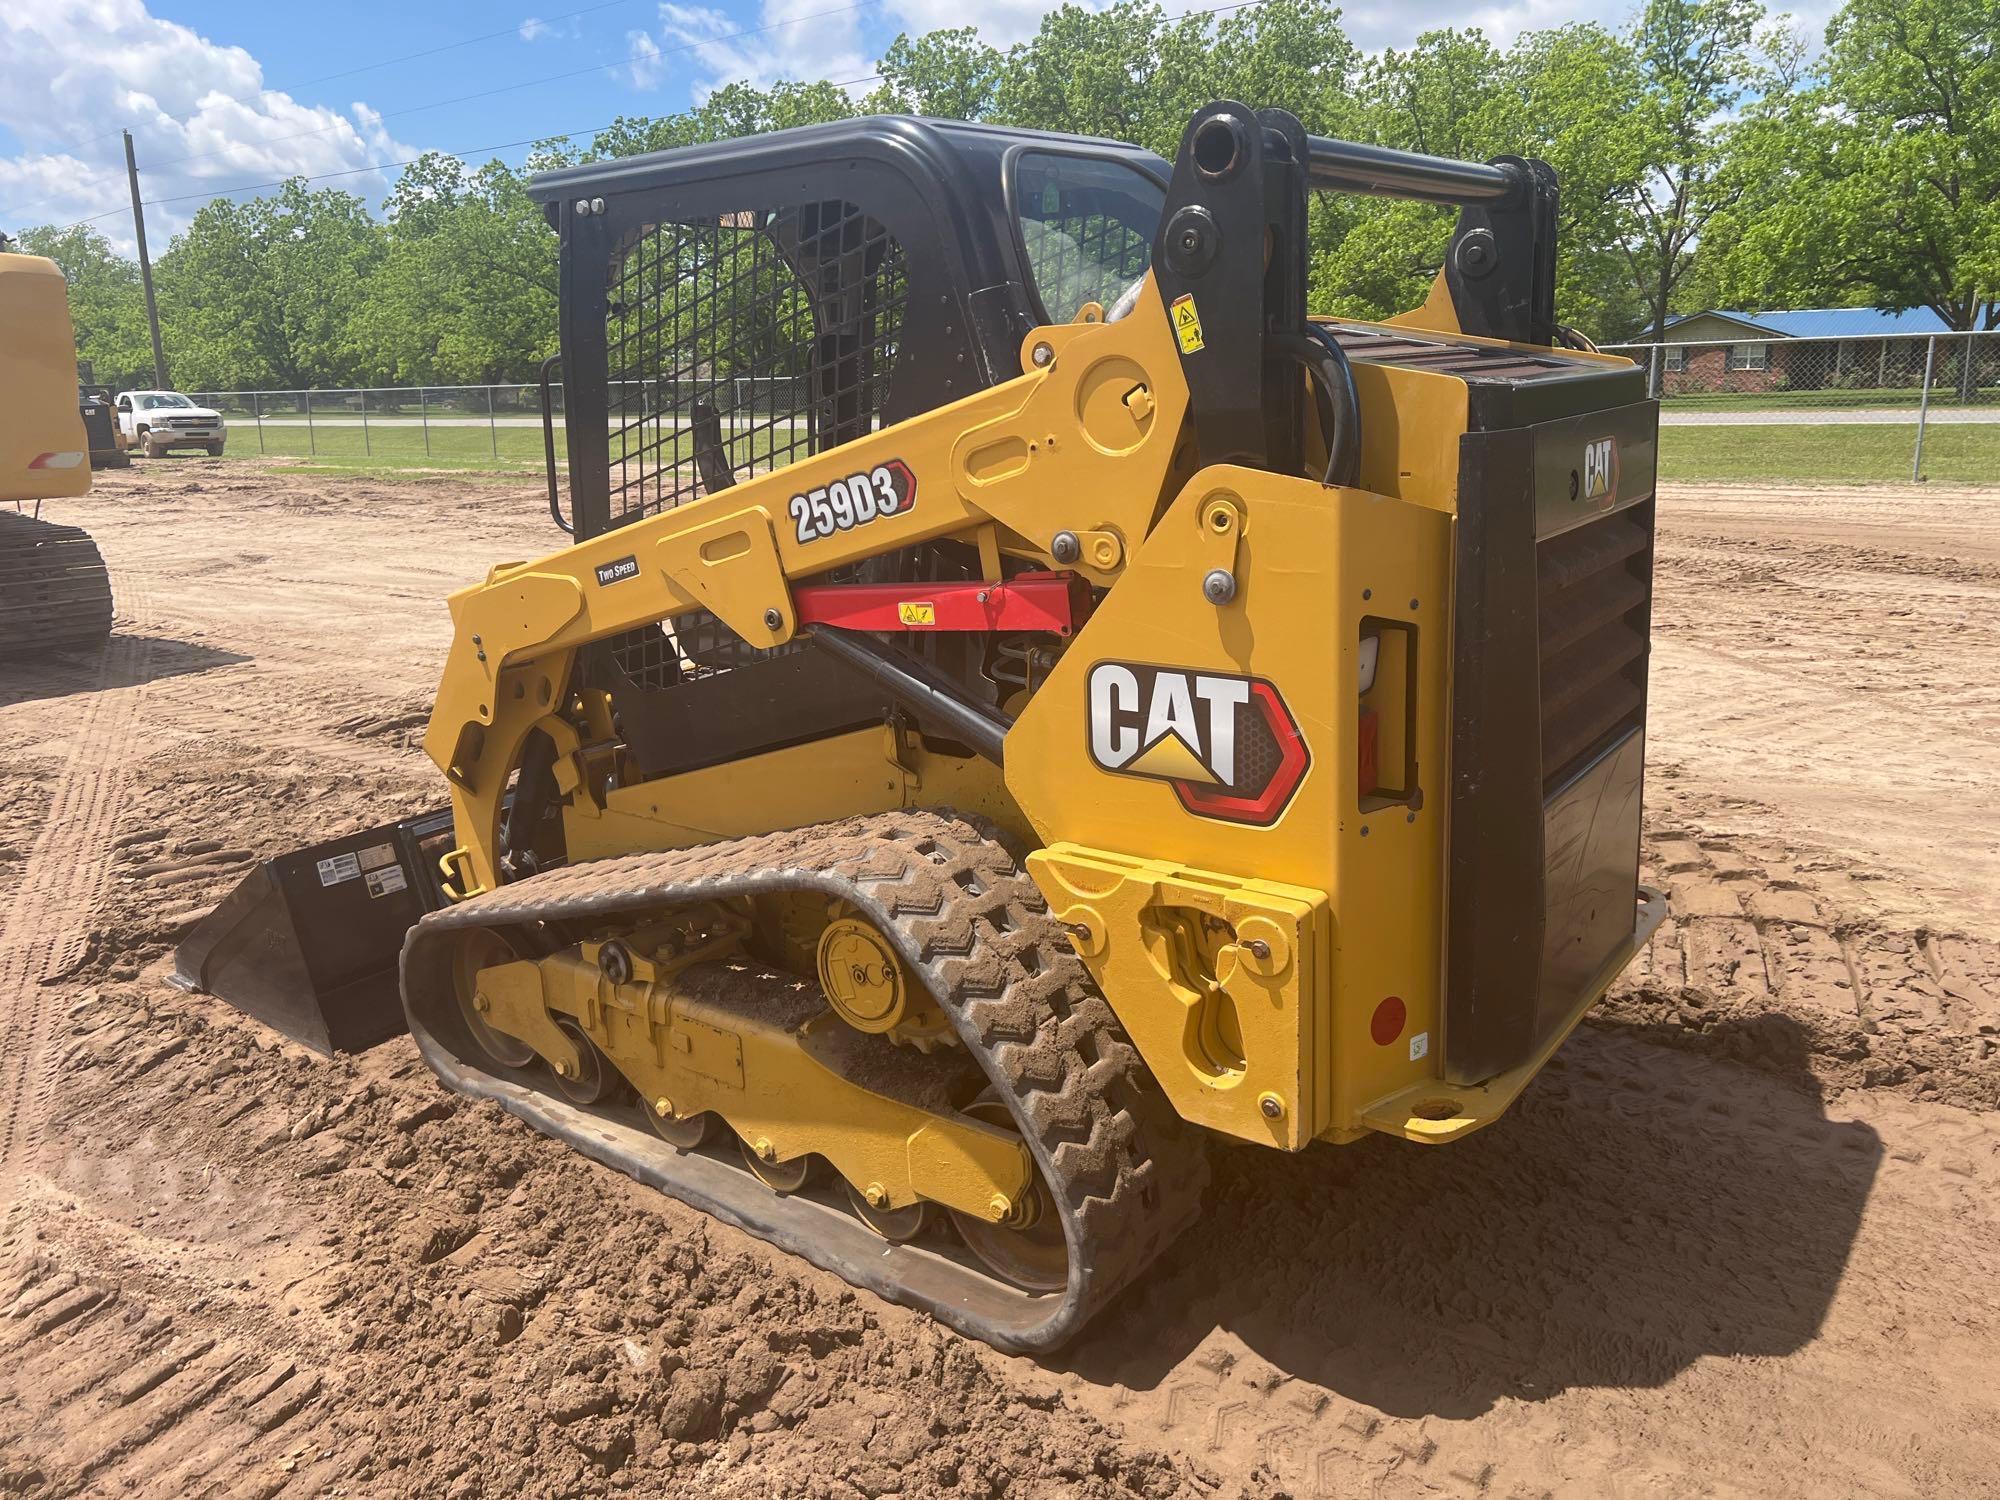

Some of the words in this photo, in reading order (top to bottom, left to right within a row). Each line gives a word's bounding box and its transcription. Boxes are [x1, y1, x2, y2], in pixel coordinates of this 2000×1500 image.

[790, 467, 898, 542] 259D3
[1585, 440, 1611, 497] CAT
[1091, 664, 1249, 786] CAT
